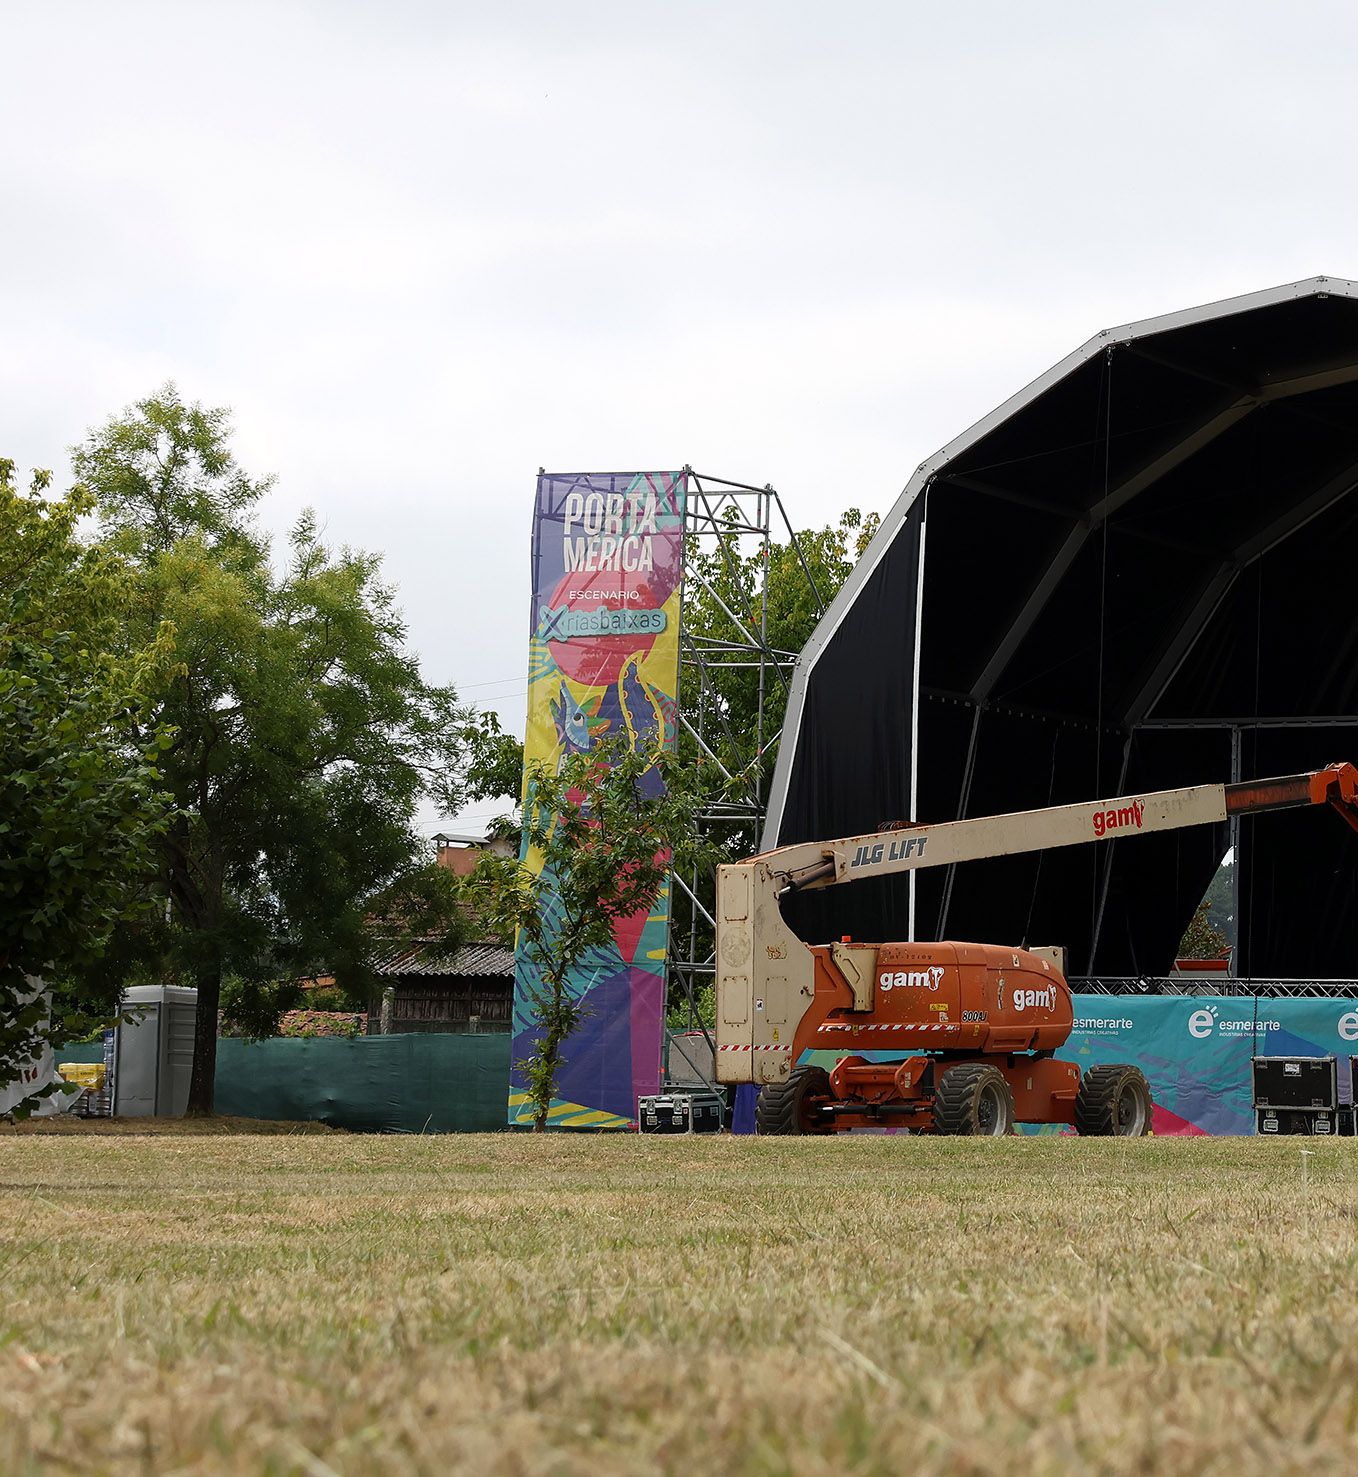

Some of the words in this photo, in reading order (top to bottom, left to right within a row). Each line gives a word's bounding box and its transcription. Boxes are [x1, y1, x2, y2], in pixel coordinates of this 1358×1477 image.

[564, 493, 657, 535] PORTA
[563, 533, 653, 573] MÉRICA
[569, 590, 640, 600] ESCENARIO
[851, 844, 884, 867] JLG
[888, 837, 928, 862] LIFT
[962, 1010, 987, 1022] 800AJ
[1072, 1017, 1133, 1029] esmerarte
[1219, 1019, 1280, 1031] esmerarte
